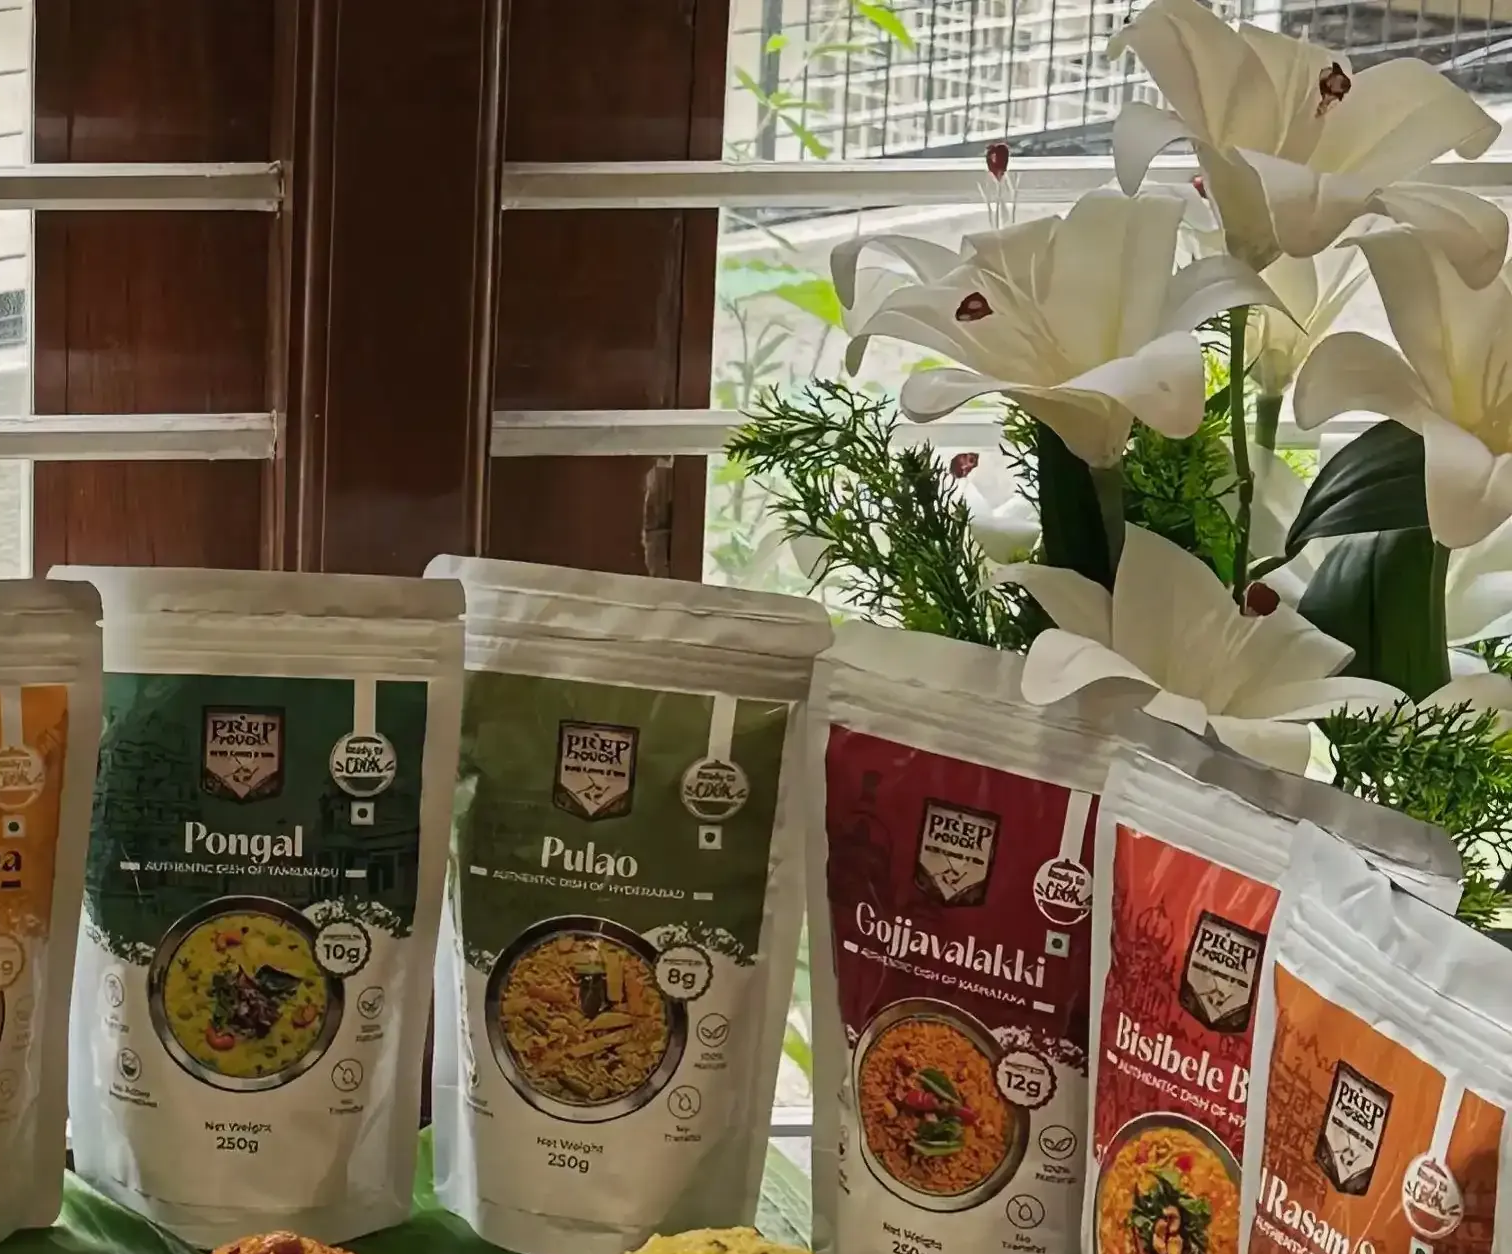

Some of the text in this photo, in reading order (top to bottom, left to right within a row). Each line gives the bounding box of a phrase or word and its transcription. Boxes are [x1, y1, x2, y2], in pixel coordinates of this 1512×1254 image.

[211, 719, 276, 745] PREP
[566, 733, 630, 764] PREP
[184, 821, 303, 864] Pongal
[928, 814, 993, 850] PREP
[934, 832, 976, 849] POUCH
[541, 836, 638, 878] Pulao
[323, 943, 361, 964] 10g
[856, 901, 1046, 988] Gojjavalakki
[1197, 928, 1256, 973] PREP
[667, 969, 696, 989] 8g
[1115, 1012, 1225, 1093] Bisibele
[1004, 1070, 1041, 1098] 12g
[1117, 1060, 1178, 1098] AUTHENTIC
[1336, 1081, 1384, 1130] PREP
[216, 1136, 259, 1153] 250g
[547, 1152, 590, 1173] 250g
